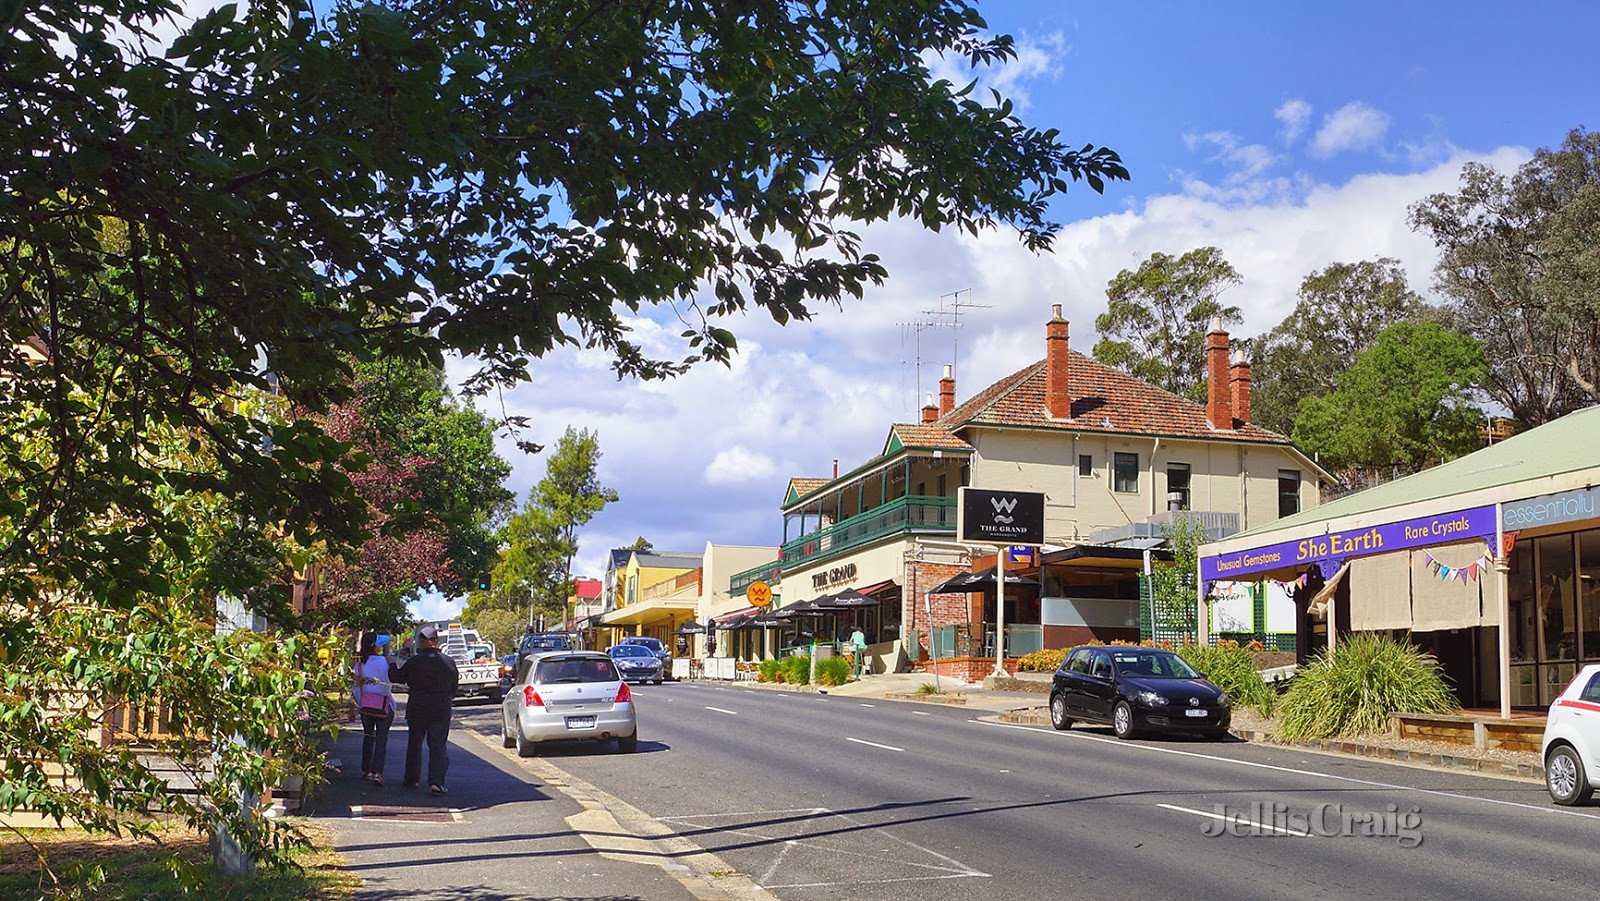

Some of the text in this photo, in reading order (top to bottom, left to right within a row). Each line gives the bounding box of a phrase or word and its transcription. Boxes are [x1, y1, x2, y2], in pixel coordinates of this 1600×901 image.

[1504, 493, 1595, 525] essentially
[999, 525, 1027, 533] GRAND
[1405, 516, 1470, 541] Rare Crystals
[1297, 528, 1383, 561] She Earth
[1217, 551, 1281, 572] Unusual Gemstones
[811, 562, 857, 588] THE GRAND
[458, 671, 492, 681] OYOTA
